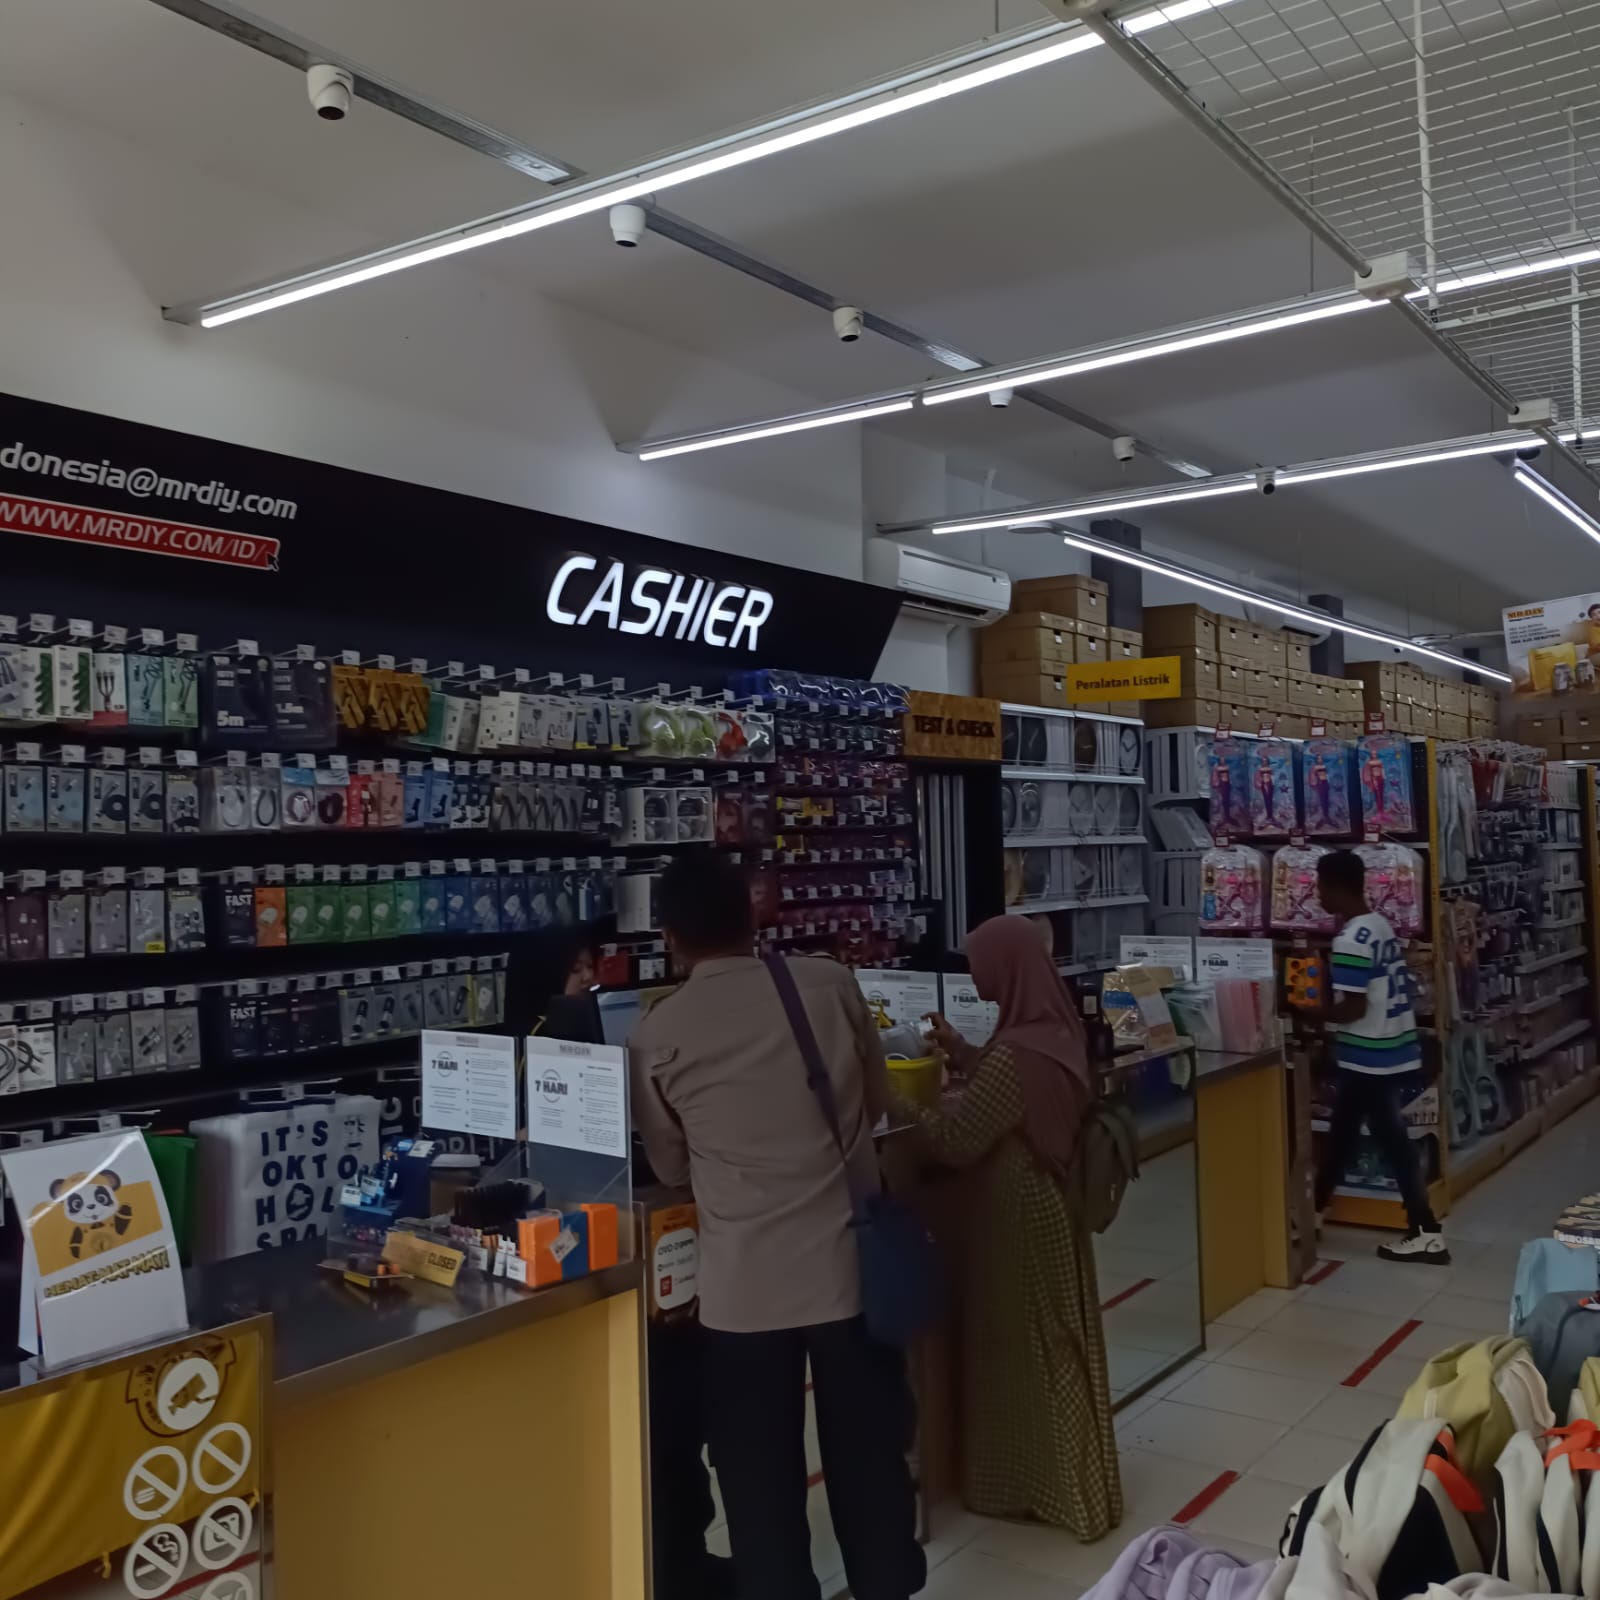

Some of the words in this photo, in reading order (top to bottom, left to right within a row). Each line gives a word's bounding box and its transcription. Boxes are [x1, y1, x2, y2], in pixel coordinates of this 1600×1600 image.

[0, 441, 298, 520] donesia@mrdiy.com
[546, 554, 774, 652] CASHIER
[1076, 678, 1130, 690] Peralatan
[1133, 673, 1170, 687] Listrik
[913, 715, 943, 734] TEST
[946, 717, 954, 735] &
[957, 718, 995, 738] CHECK
[225, 894, 252, 907] FAST
[1355, 926, 1371, 944] 8
[230, 1007, 257, 1020] FAST
[431, 1059, 438, 1070] 7
[438, 1060, 459, 1072] HARI
[535, 1080, 542, 1093] 7
[543, 1080, 569, 1096] HARI
[261, 1120, 328, 1156] IT'S
